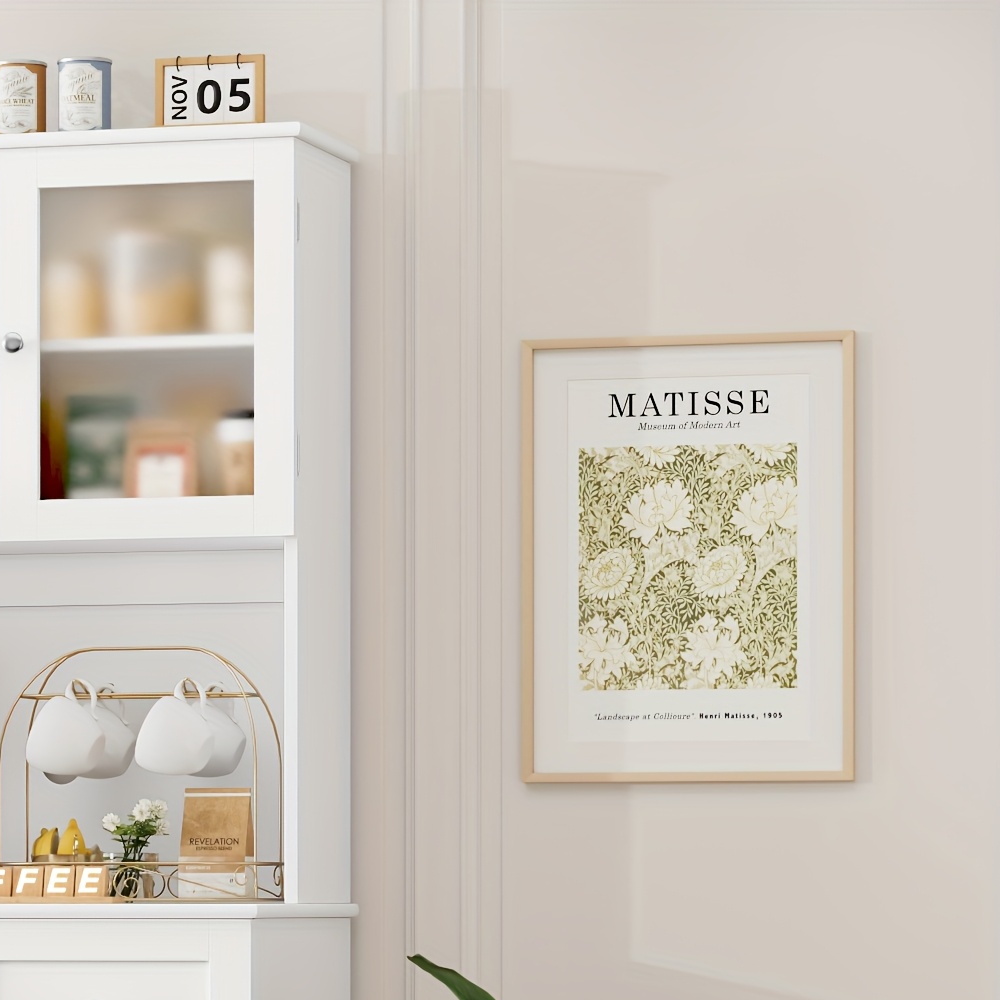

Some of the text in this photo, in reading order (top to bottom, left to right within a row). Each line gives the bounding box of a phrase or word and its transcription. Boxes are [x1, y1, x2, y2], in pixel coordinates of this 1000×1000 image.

[171, 75, 188, 120] NOV
[608, 389, 769, 418] MATISSE
[637, 420, 741, 431] Museum of Modern Art
[724, 712, 759, 721] Matisse,
[763, 712, 784, 720] 1905
[189, 837, 240, 846] REVELATION
